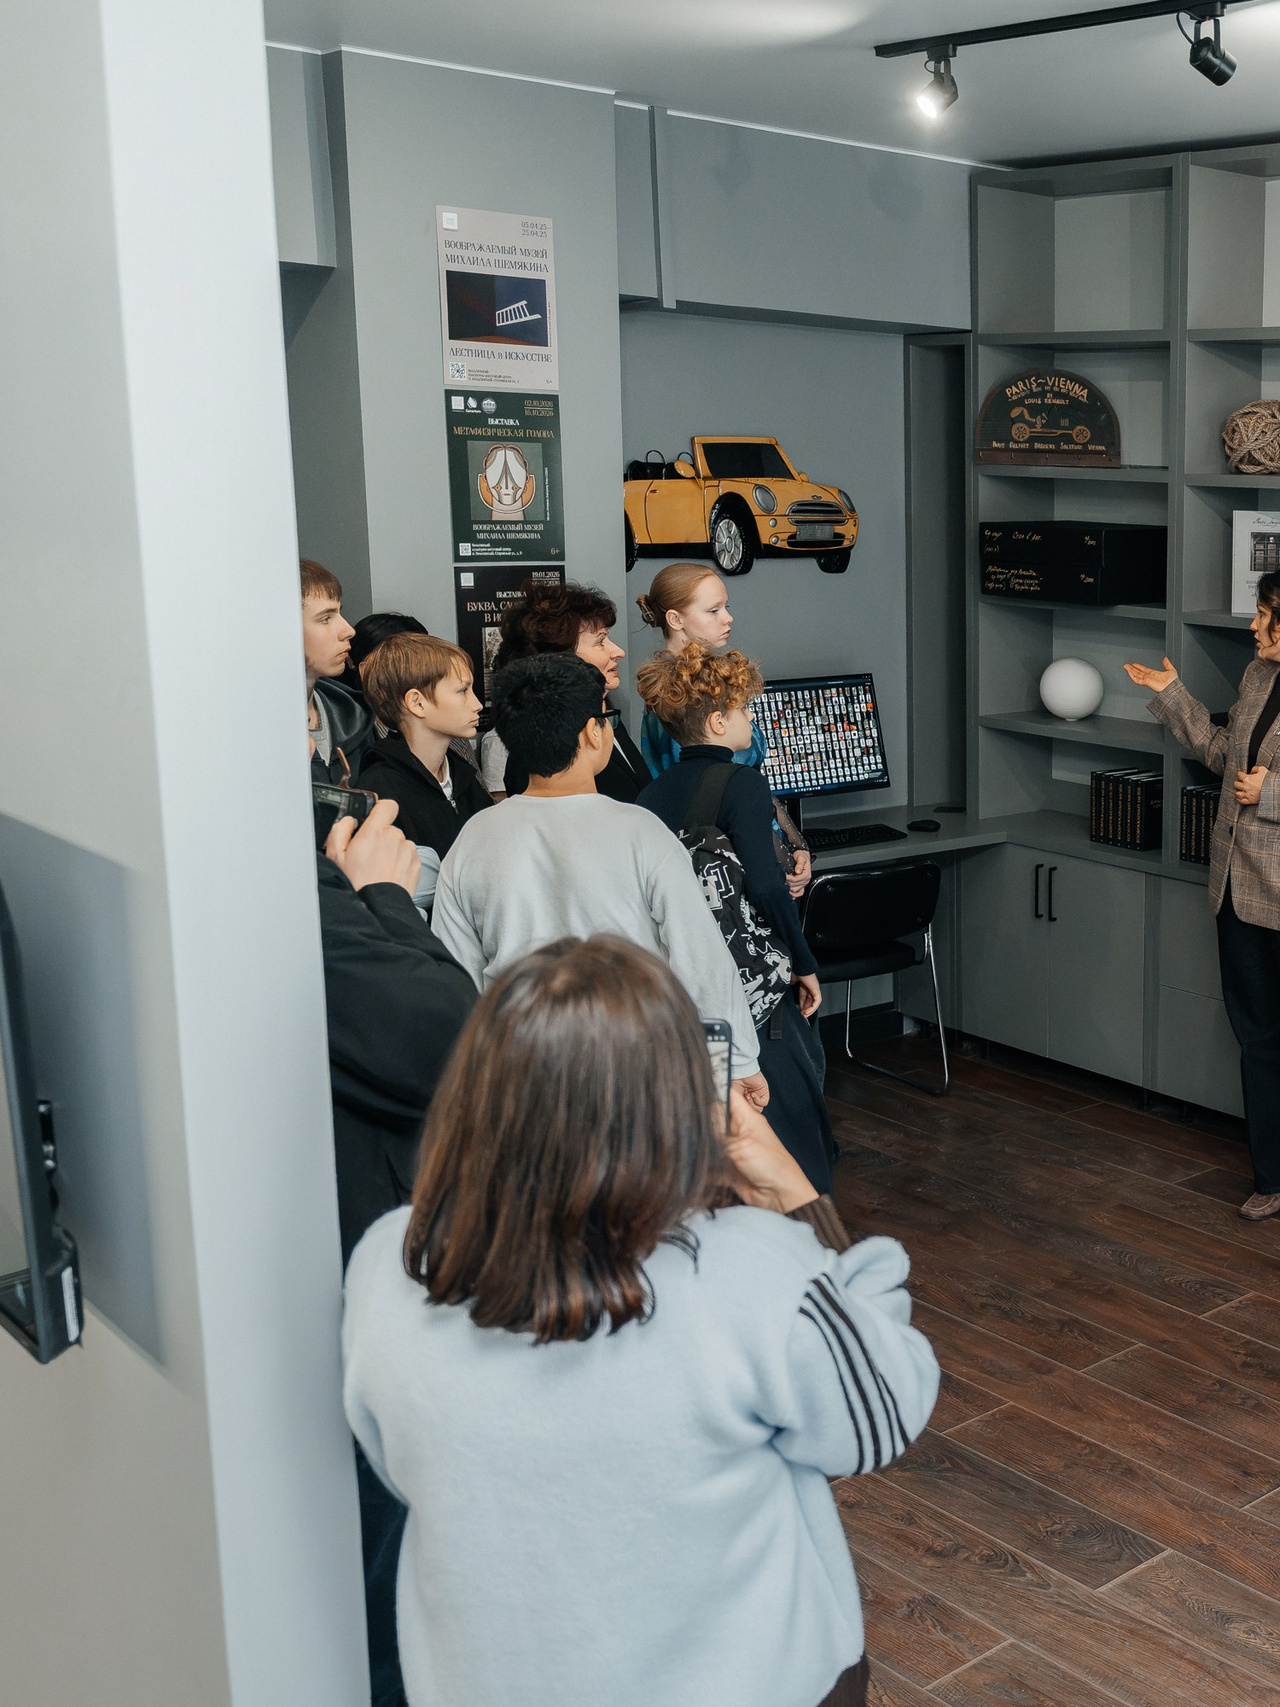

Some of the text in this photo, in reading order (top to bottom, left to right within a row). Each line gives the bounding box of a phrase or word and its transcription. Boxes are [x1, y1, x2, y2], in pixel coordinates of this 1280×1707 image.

[444, 240, 548, 259] ВООБРАЖАЕМЫЙ МУЗЕЙ
[445, 254, 549, 273] МИХАИЛА ШЕМЯКИНА
[449, 348, 496, 360] ЛЕСТНИЦА
[504, 352, 552, 362] ИСКУССТВЕ
[488, 418, 520, 426] ВЫСТАВКА
[467, 601, 498, 612] БУКВА,
